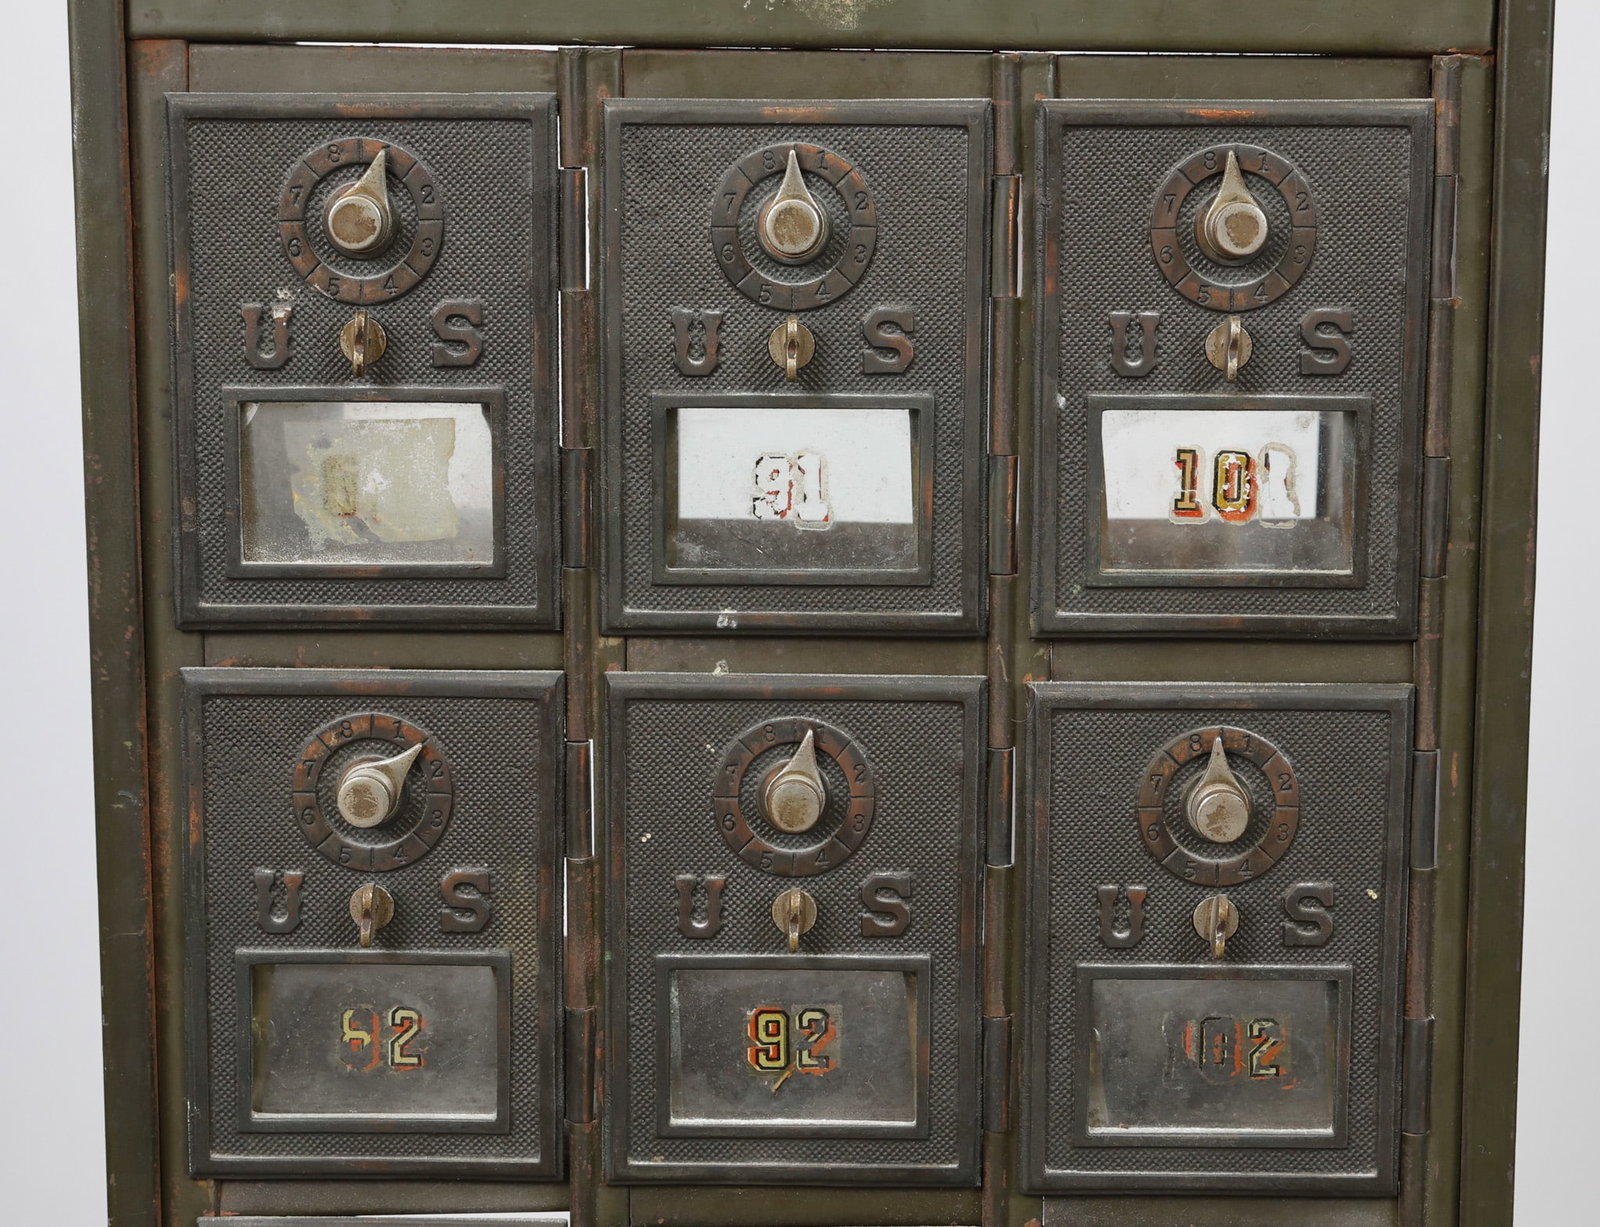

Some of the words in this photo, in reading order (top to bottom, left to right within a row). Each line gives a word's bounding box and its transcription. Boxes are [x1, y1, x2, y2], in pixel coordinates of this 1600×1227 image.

[328, 144, 340, 163] 8
[763, 151, 775, 170] 8
[816, 150, 828, 170] 1
[1204, 152, 1216, 170] 8
[1258, 152, 1269, 172] 1
[290, 185, 303, 205] 7
[421, 184, 435, 204] 2
[724, 192, 736, 214] 7
[855, 191, 868, 210] 2
[1295, 192, 1309, 211] 2
[1164, 194, 1176, 215] 7
[288, 237, 301, 257] 6
[421, 238, 434, 257] 3
[721, 243, 735, 262] 6
[854, 244, 867, 263] 3
[1160, 246, 1173, 264] 6
[1293, 246, 1306, 264] 3
[328, 278, 340, 296] 5
[383, 275, 398, 294] 4
[759, 284, 773, 304] 5
[815, 282, 830, 301] 4
[1198, 285, 1211, 303] 5
[1254, 283, 1269, 302] 4
[241, 303, 292, 370] U
[432, 301, 482, 367] S
[671, 308, 723, 376] U
[863, 307, 914, 375] S
[1108, 311, 1160, 377] U
[1301, 308, 1352, 375] S
[340, 720, 353, 738] 8
[393, 720, 405, 740] 1
[763, 725, 775, 742] 8
[1190, 734, 1202, 752] 8
[1243, 736, 1253, 755] 1
[303, 760, 316, 779] 7
[430, 760, 443, 780] 2
[854, 764, 866, 783] 2
[1151, 775, 1163, 793] 7
[1279, 773, 1292, 792] 2
[301, 808, 315, 826] 6
[431, 810, 443, 828] 3
[722, 813, 735, 831] 6
[853, 814, 865, 833] 3
[1147, 823, 1160, 842] 6
[1277, 823, 1289, 842] 3
[339, 848, 351, 865] 5
[393, 846, 408, 864] 4
[760, 852, 773, 870] 5
[815, 850, 830, 868] 4
[1184, 861, 1196, 879] 5
[1239, 859, 1254, 878] 4
[254, 869, 304, 933] U
[441, 868, 492, 932] S
[675, 874, 725, 939] U
[861, 872, 912, 937] S
[1098, 885, 1147, 948] U
[1283, 882, 1334, 947] S
[747, 1006, 837, 1075] 92
